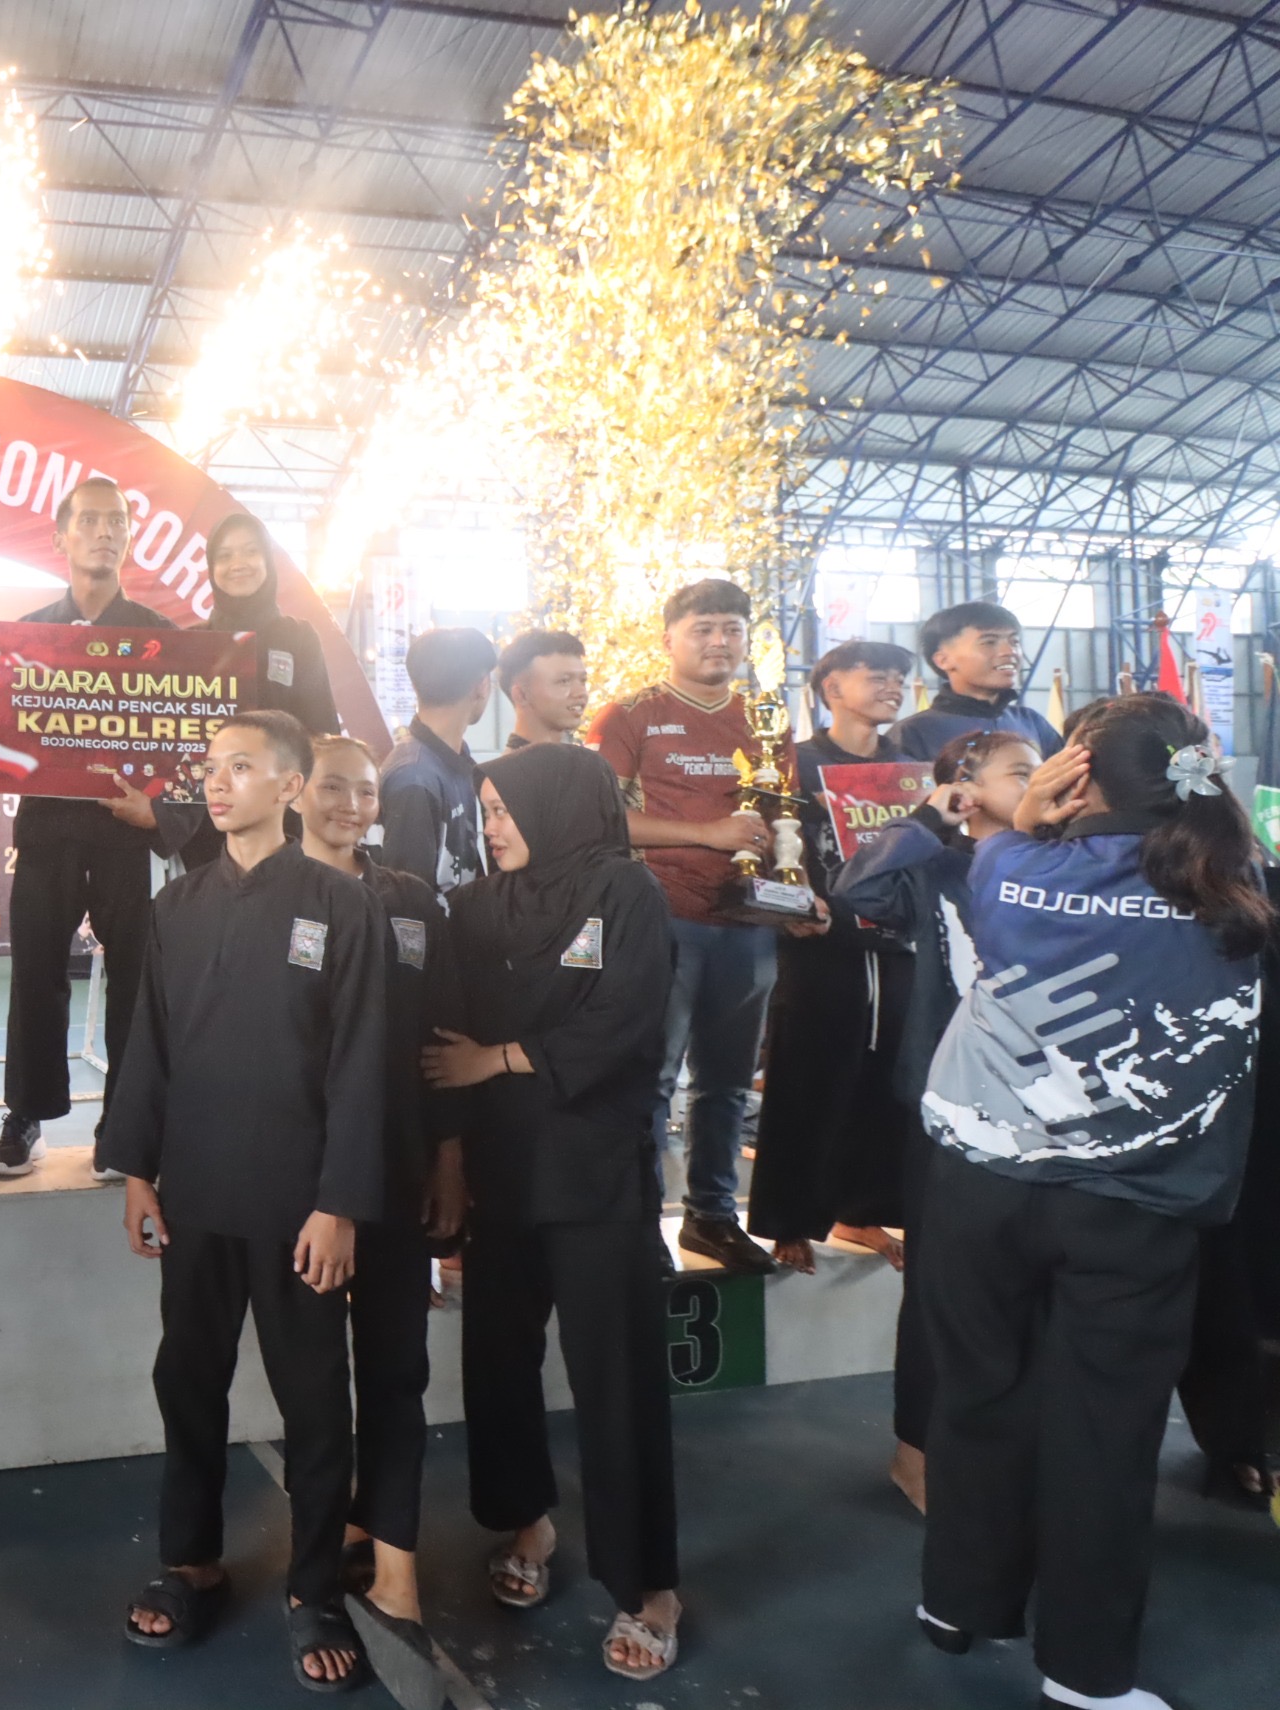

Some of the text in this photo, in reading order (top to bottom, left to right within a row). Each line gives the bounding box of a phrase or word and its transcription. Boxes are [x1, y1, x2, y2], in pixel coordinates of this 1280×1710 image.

[11, 666, 238, 700] JUARA UMUM I
[11, 694, 238, 716] KEJUARAAN PENCAK SILAT
[17, 710, 226, 741] KAPOLRES
[40, 736, 206, 753] BOJONEGORO CUP IV 2025
[998, 881, 1196, 920] BOJONEGO
[667, 1279, 723, 1386] 3
